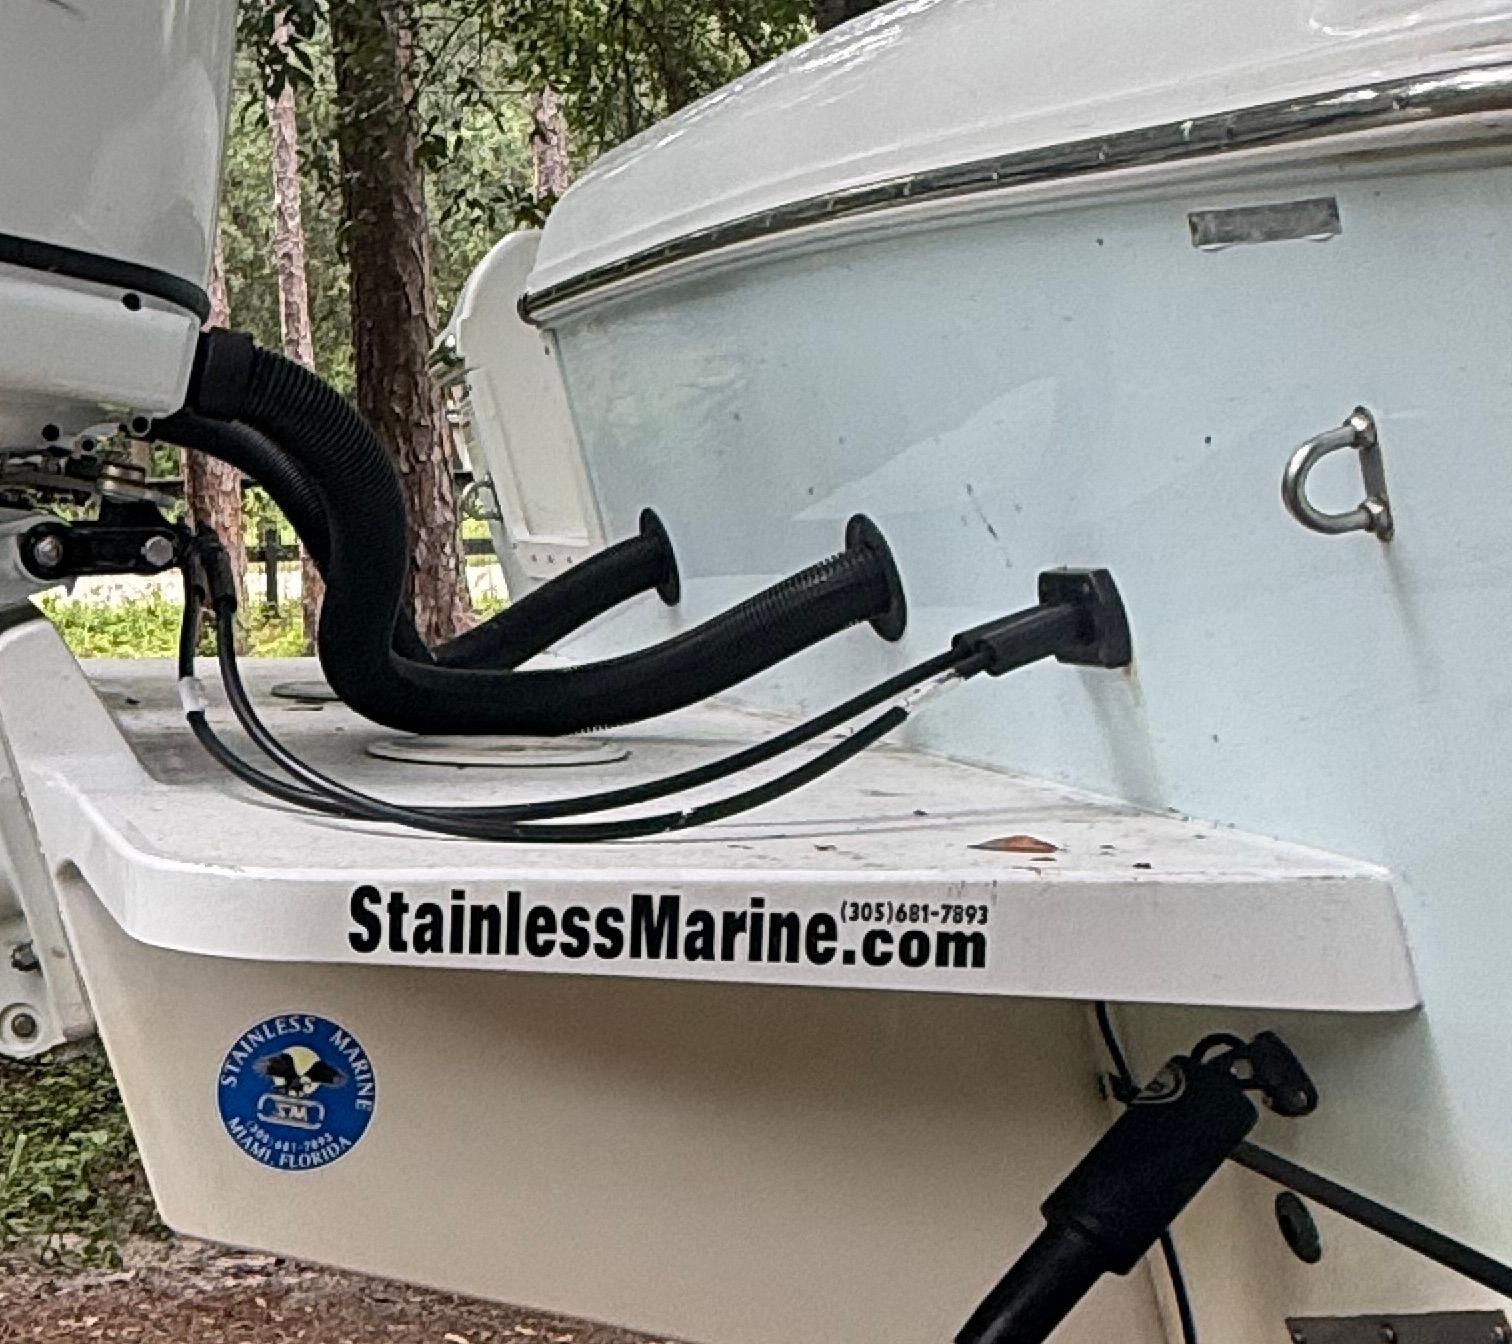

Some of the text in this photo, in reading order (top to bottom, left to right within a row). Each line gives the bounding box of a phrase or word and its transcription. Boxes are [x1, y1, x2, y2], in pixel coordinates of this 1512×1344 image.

[348, 884, 987, 969] StainlessMarine.com
[840, 899, 989, 928] (305)681-7893
[220, 1016, 373, 1112] STAINLESS MARINE
[278, 1135, 352, 1169] FLORIDA
